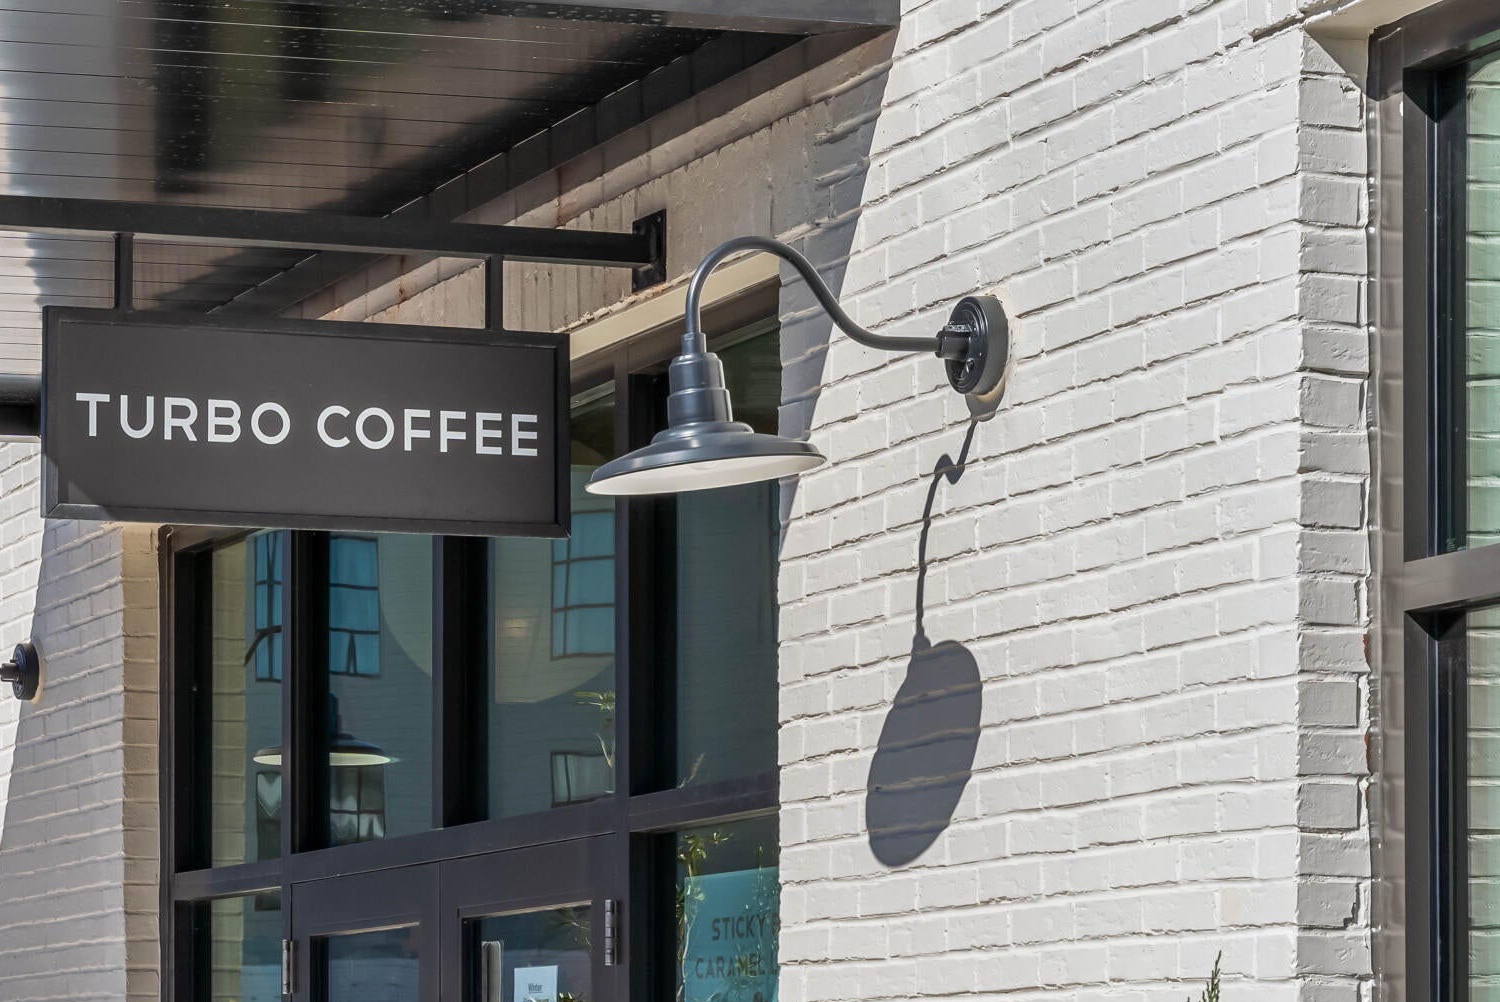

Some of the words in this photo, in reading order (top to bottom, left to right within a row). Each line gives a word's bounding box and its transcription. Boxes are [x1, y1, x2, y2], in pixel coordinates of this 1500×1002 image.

[76, 392, 291, 445] TURBO
[317, 405, 538, 457] COFFEE
[711, 914, 766, 942] STICKY
[695, 953, 765, 980] CARAMEL
